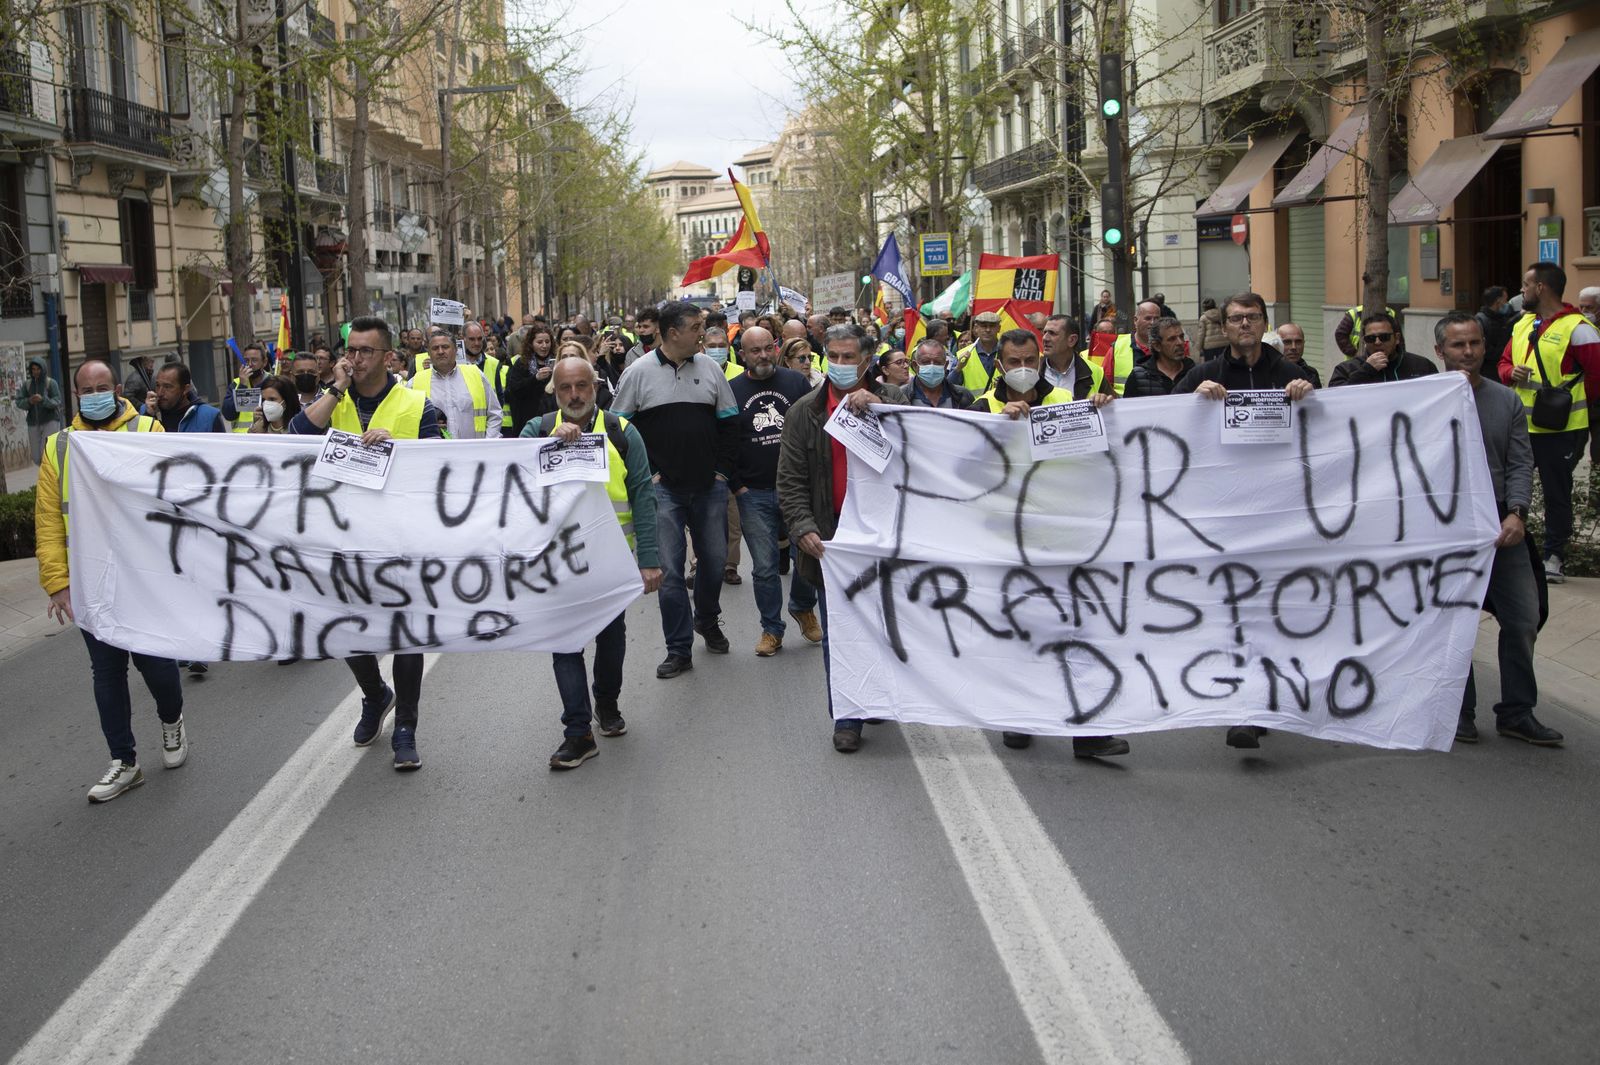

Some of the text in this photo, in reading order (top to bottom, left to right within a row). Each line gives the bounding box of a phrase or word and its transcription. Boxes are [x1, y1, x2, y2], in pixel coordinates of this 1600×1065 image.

[1542, 241, 1556, 259] AT
[1021, 268, 1037, 278] YO
[1020, 278, 1040, 290] NO
[1014, 288, 1043, 300] VOTO
[1055, 407, 1089, 416] INDEFINIDO
[1058, 416, 1090, 424] PLATAFORMA
[150, 453, 550, 534] POR UN
[872, 406, 1463, 565] POR UN
[145, 511, 589, 609] TRANSPORTE
[844, 550, 1485, 664] TRANSPORTE
[1037, 639, 1376, 726] DIGNO
